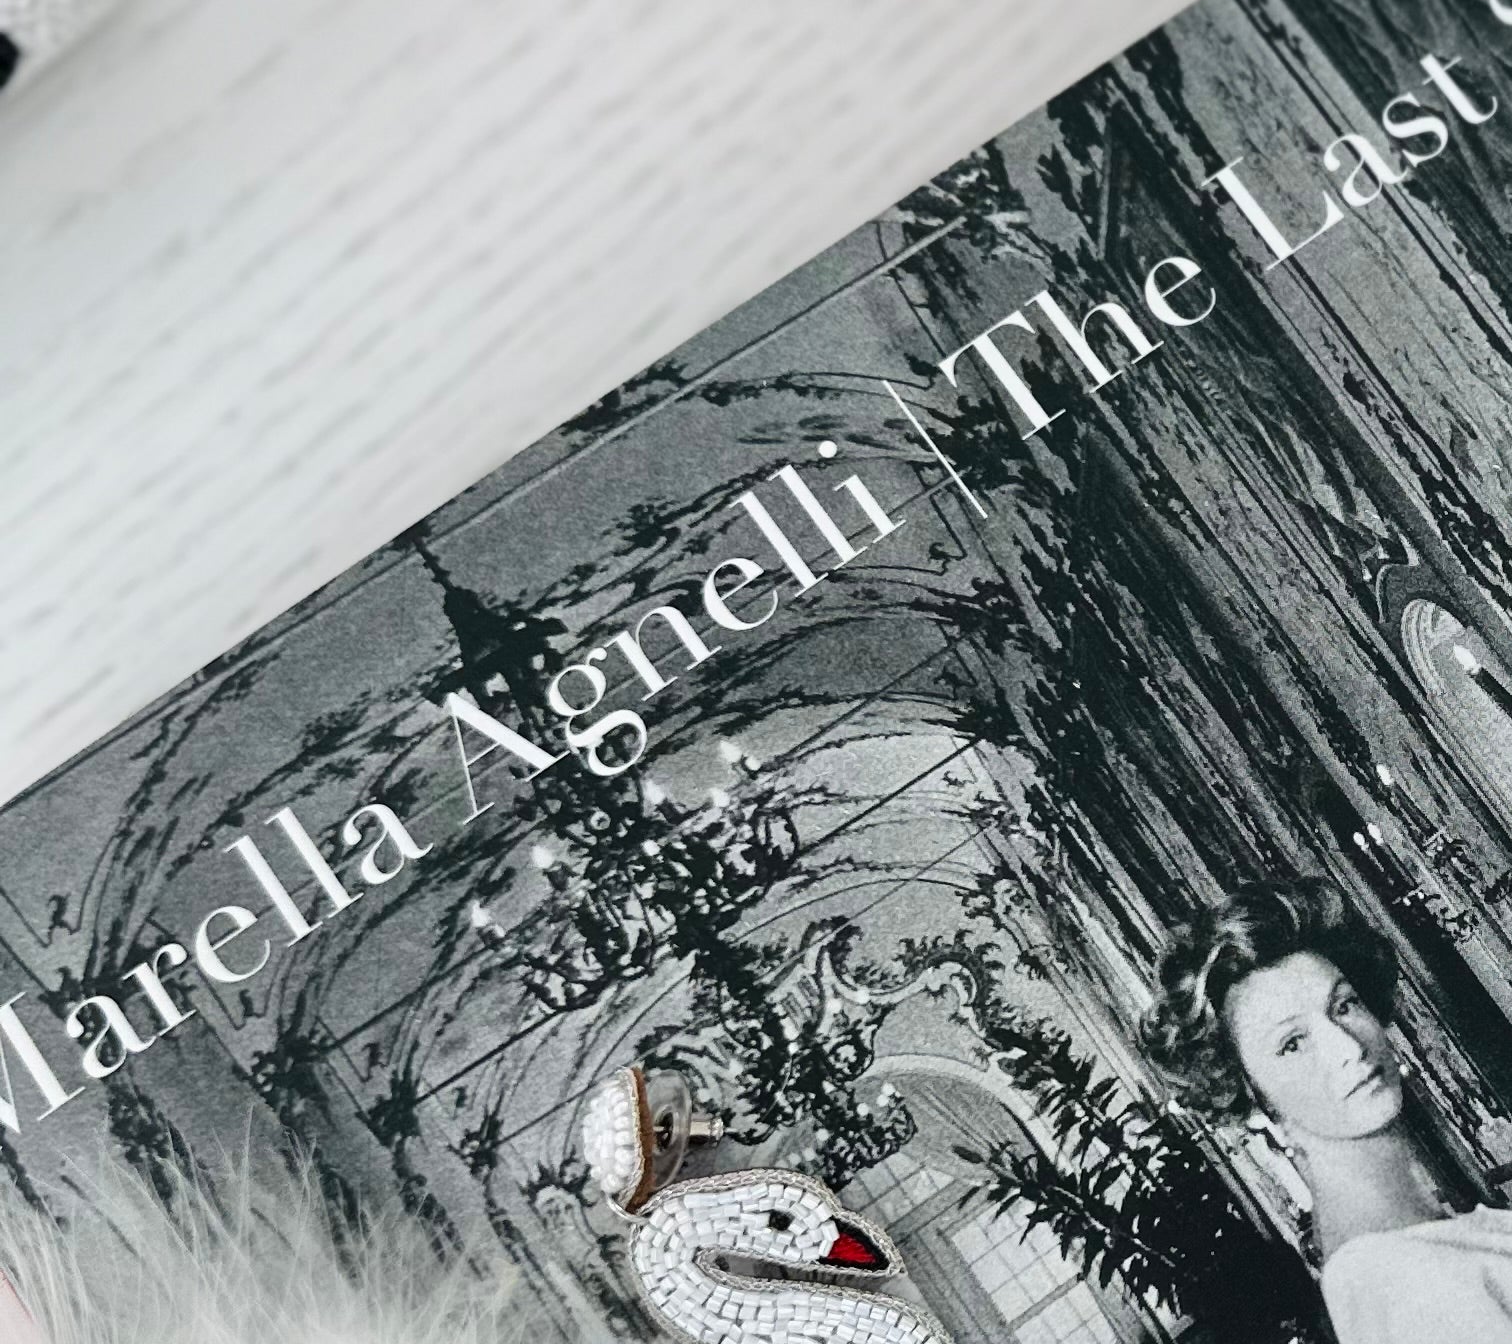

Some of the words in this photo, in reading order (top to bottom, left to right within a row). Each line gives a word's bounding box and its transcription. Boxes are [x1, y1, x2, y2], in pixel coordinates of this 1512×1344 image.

[445, 440, 906, 826] Agnelli
[938, 256, 1217, 441] The
[1201, 53, 1498, 271] Last
